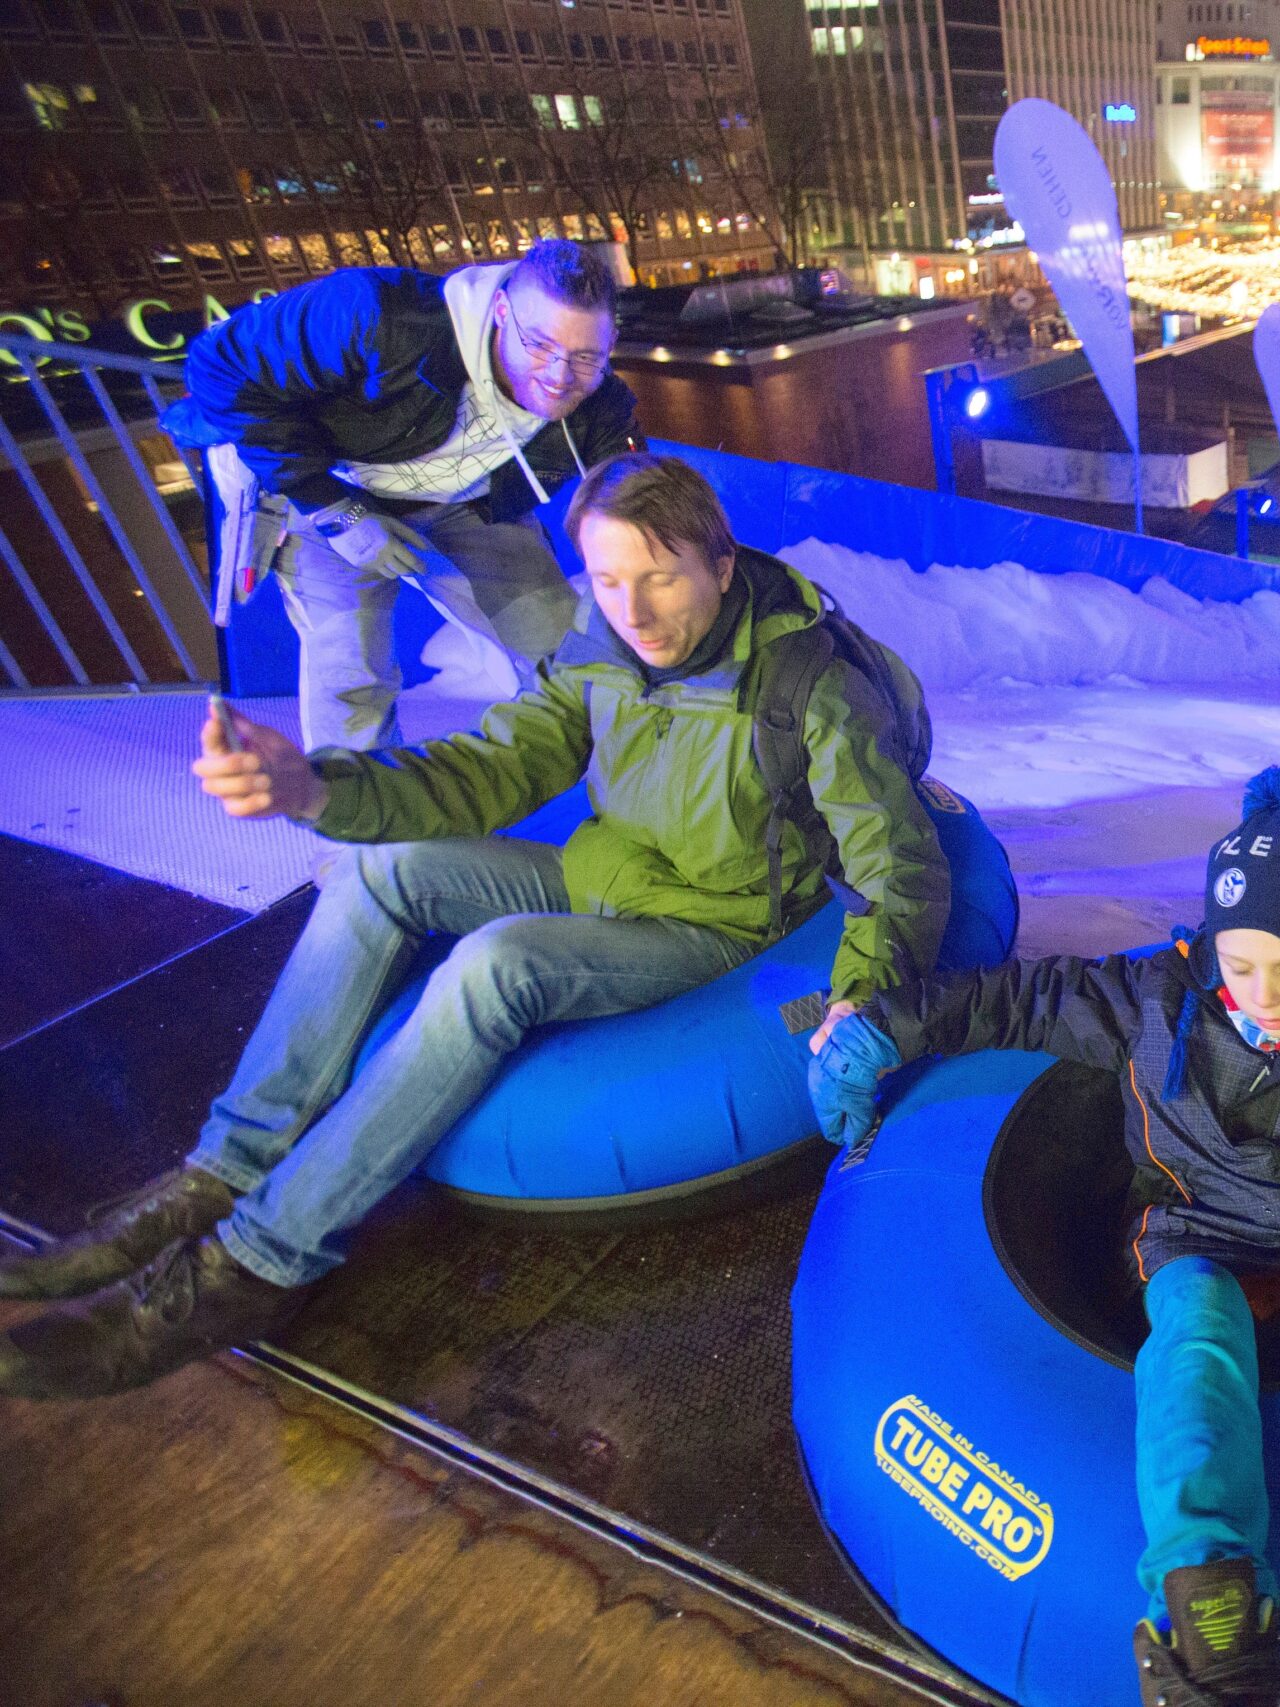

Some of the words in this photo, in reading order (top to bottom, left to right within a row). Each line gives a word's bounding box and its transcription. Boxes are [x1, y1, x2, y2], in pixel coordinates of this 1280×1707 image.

[876, 1455, 1019, 1582] TUBEPROINC.COM
[890, 1415, 970, 1502] TUBE
[961, 1481, 1034, 1553] PRO
[907, 1395, 954, 1434] MADE
[954, 1433, 974, 1451] IN
[975, 1451, 1052, 1515] CANADA
